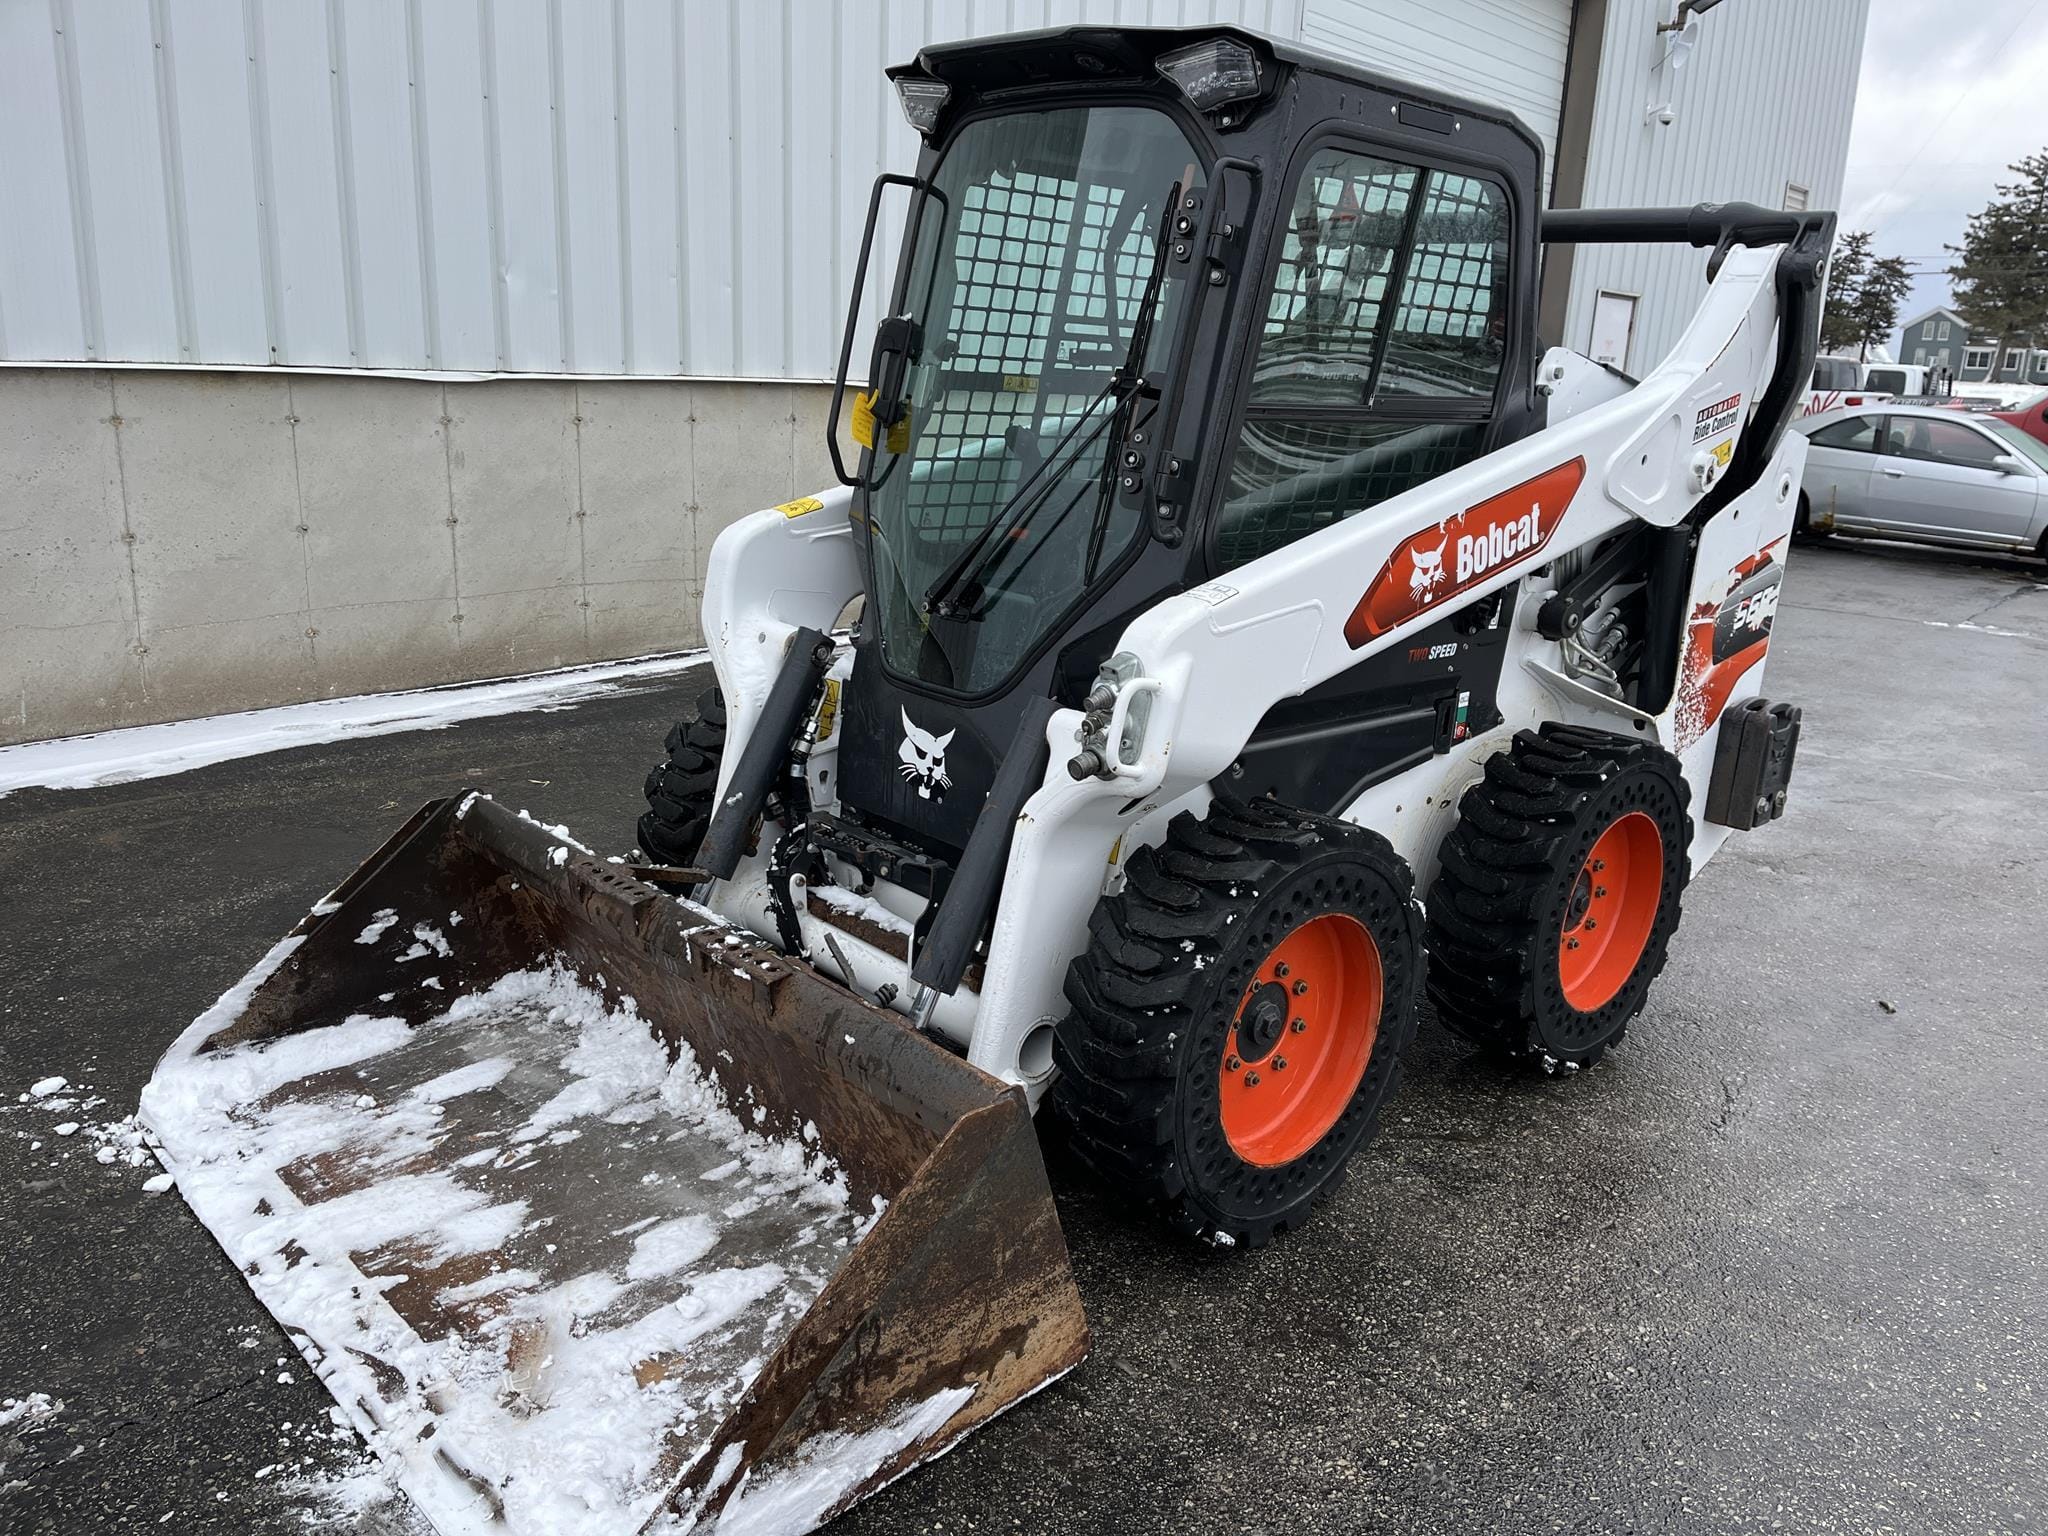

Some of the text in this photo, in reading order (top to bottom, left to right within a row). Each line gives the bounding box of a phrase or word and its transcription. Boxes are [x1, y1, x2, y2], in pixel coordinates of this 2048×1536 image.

[1698, 395, 1740, 422] AUTOMATIC
[1692, 407, 1739, 441] Ride Control
[1456, 502, 1540, 584] Bobcat
[1408, 642, 1458, 664] TWO SPEED
